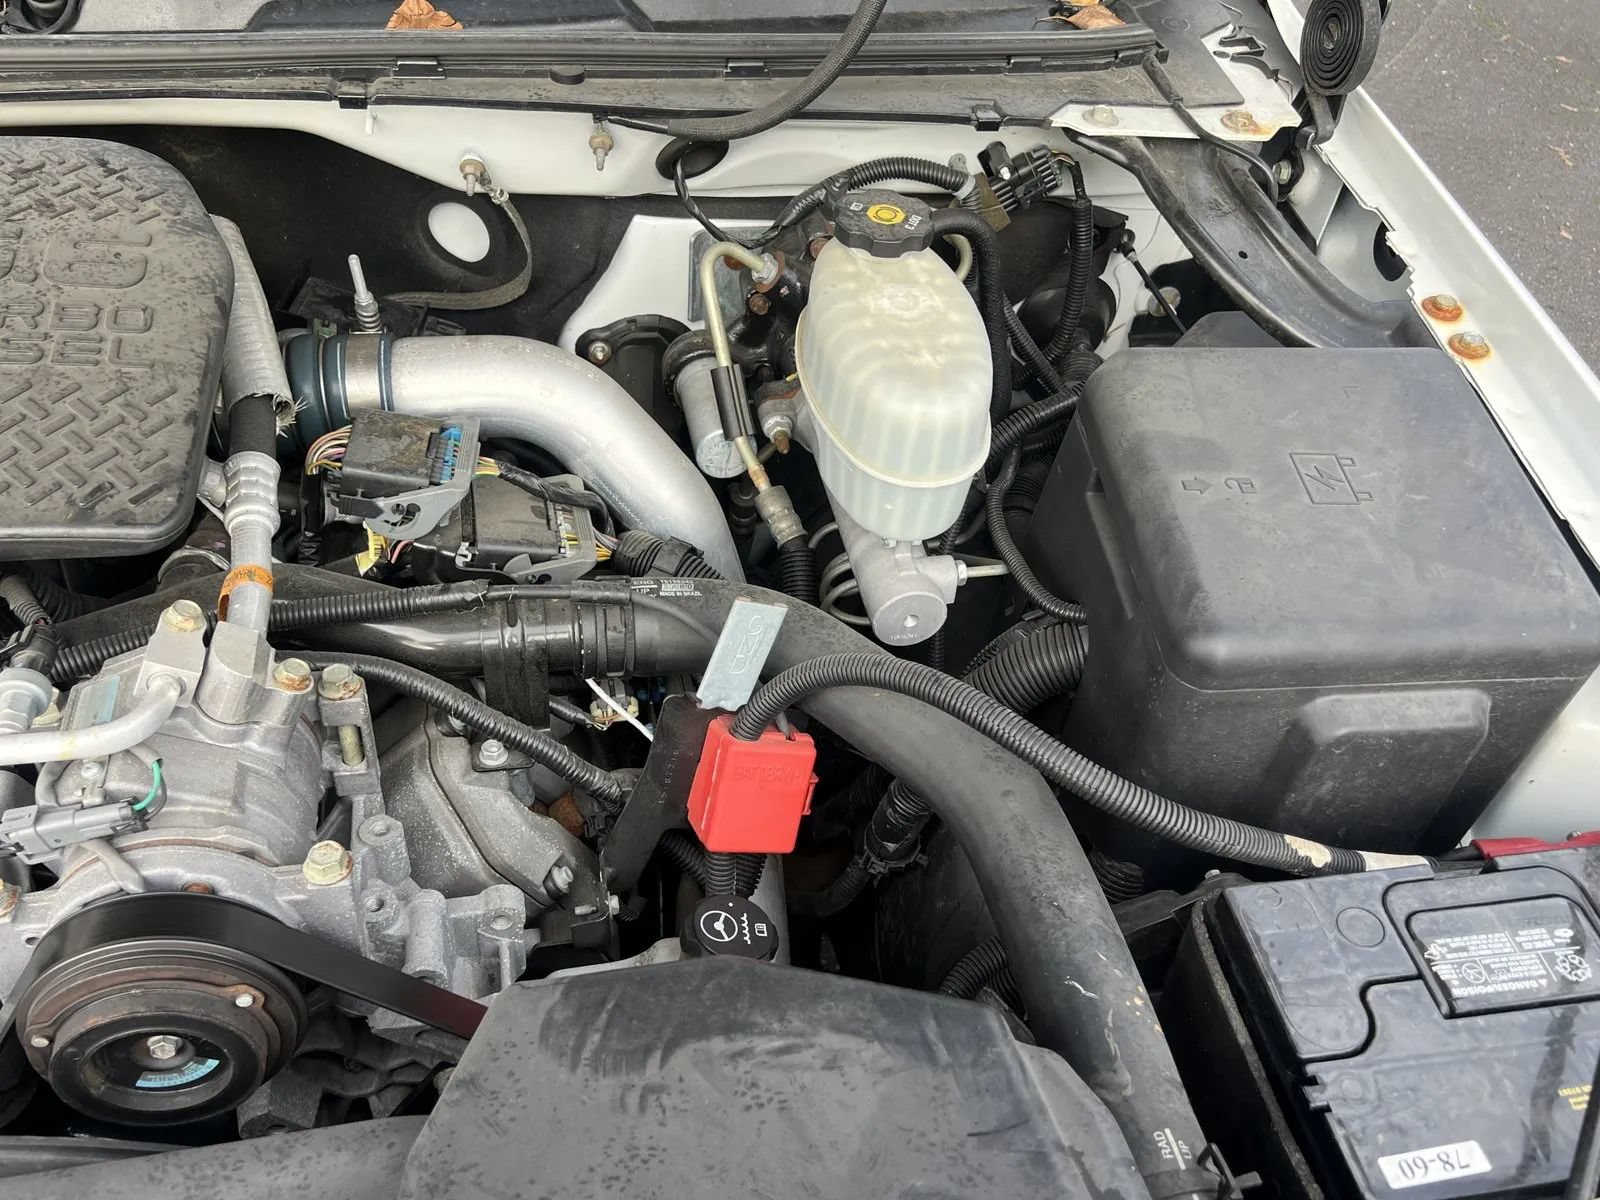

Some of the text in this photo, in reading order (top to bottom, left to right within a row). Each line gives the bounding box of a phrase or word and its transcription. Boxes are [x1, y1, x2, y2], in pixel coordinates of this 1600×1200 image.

[728, 615, 763, 675] GND
[1153, 1130, 1174, 1159] RAD
[1178, 1140, 1192, 1159] UP
[1398, 1149, 1471, 1181] 78-60
